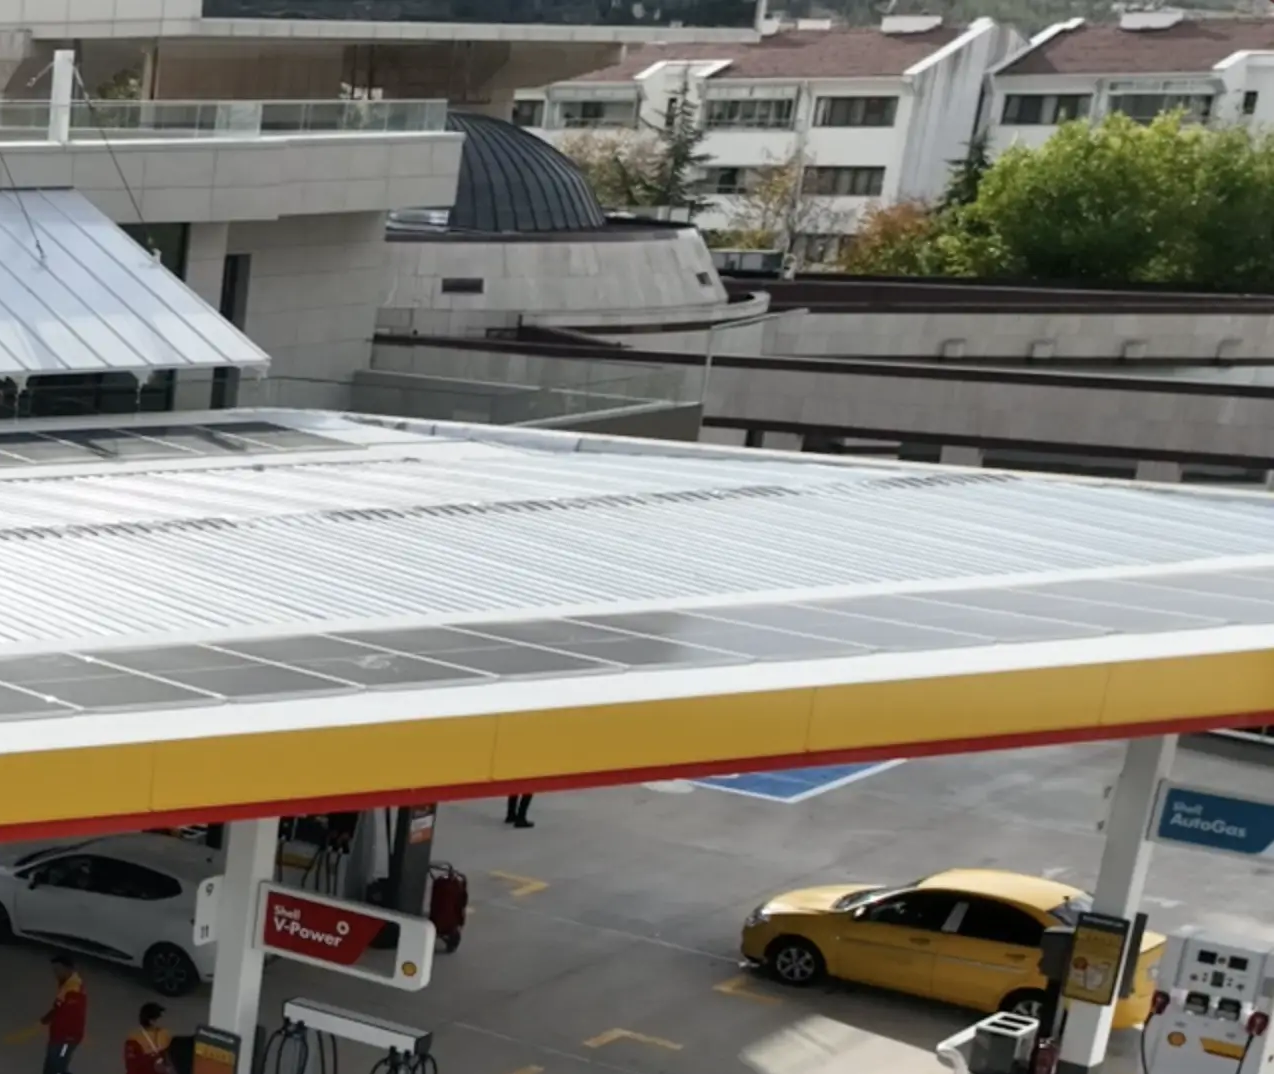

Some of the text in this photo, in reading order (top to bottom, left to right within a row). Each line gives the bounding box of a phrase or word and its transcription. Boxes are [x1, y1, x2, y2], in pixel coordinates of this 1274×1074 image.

[1170, 812, 1247, 838] AutoGas
[205, 882, 214, 896] 9
[273, 904, 301, 920] Shell
[273, 916, 343, 947] V-Power
